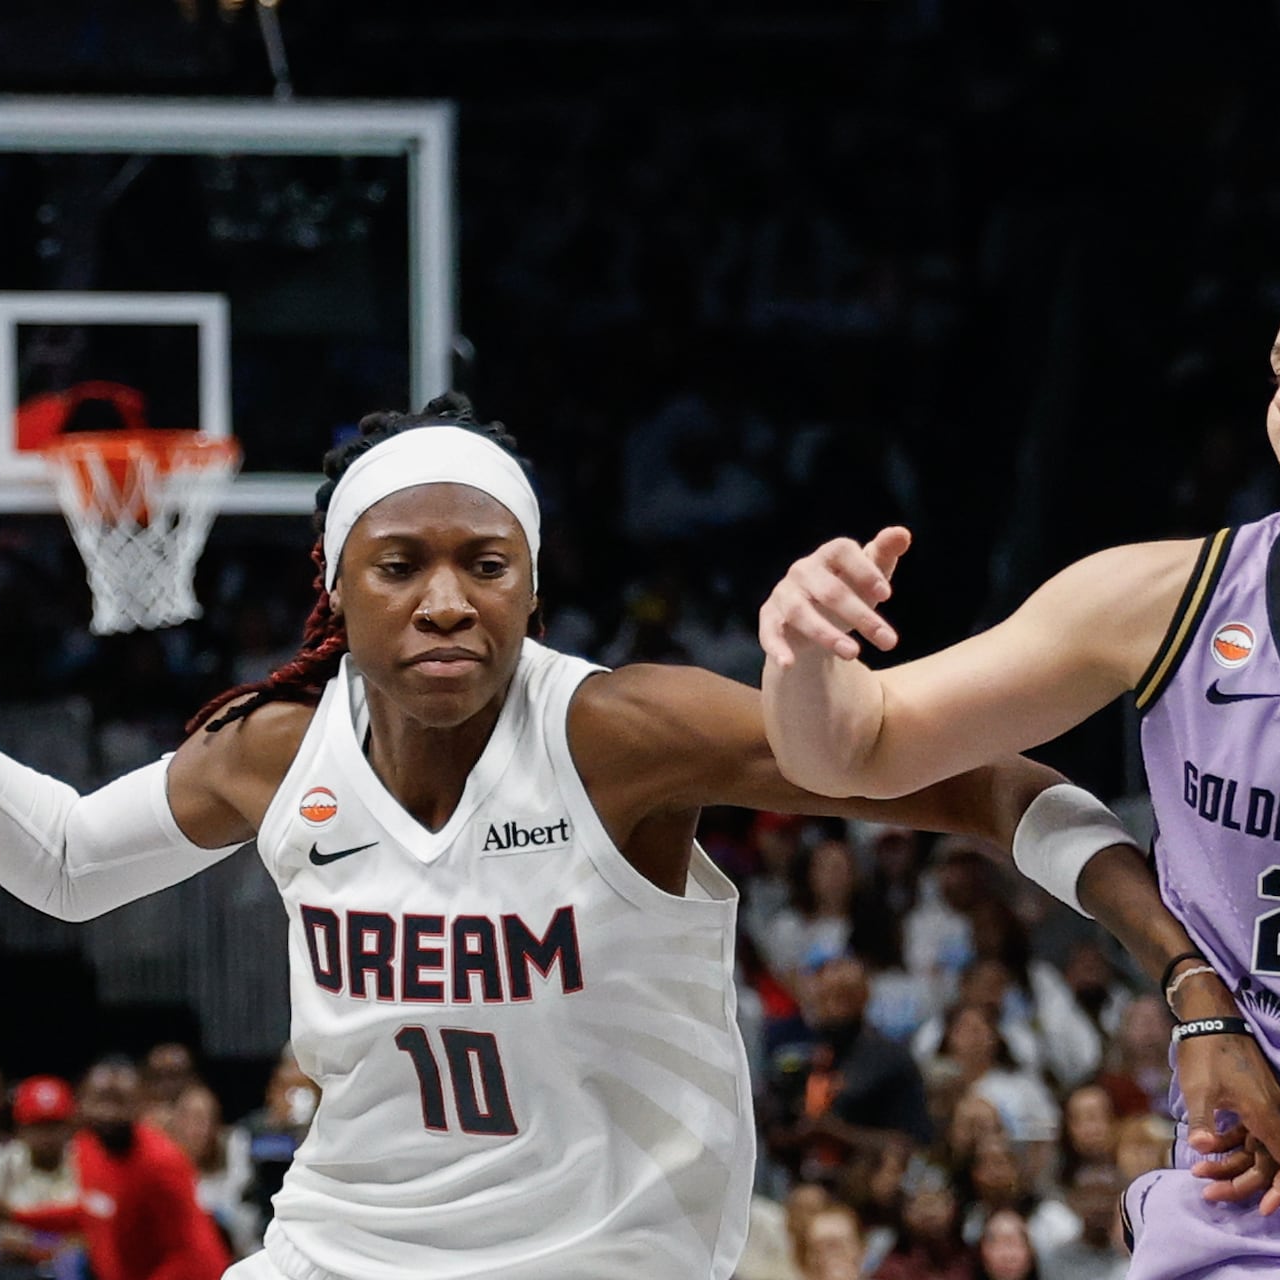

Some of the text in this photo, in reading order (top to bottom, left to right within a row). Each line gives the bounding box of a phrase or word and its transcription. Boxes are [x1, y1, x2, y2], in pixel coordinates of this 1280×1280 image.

[483, 818, 571, 852] Albert
[299, 903, 586, 1005] DREAM
[393, 1024, 520, 1137] 10
